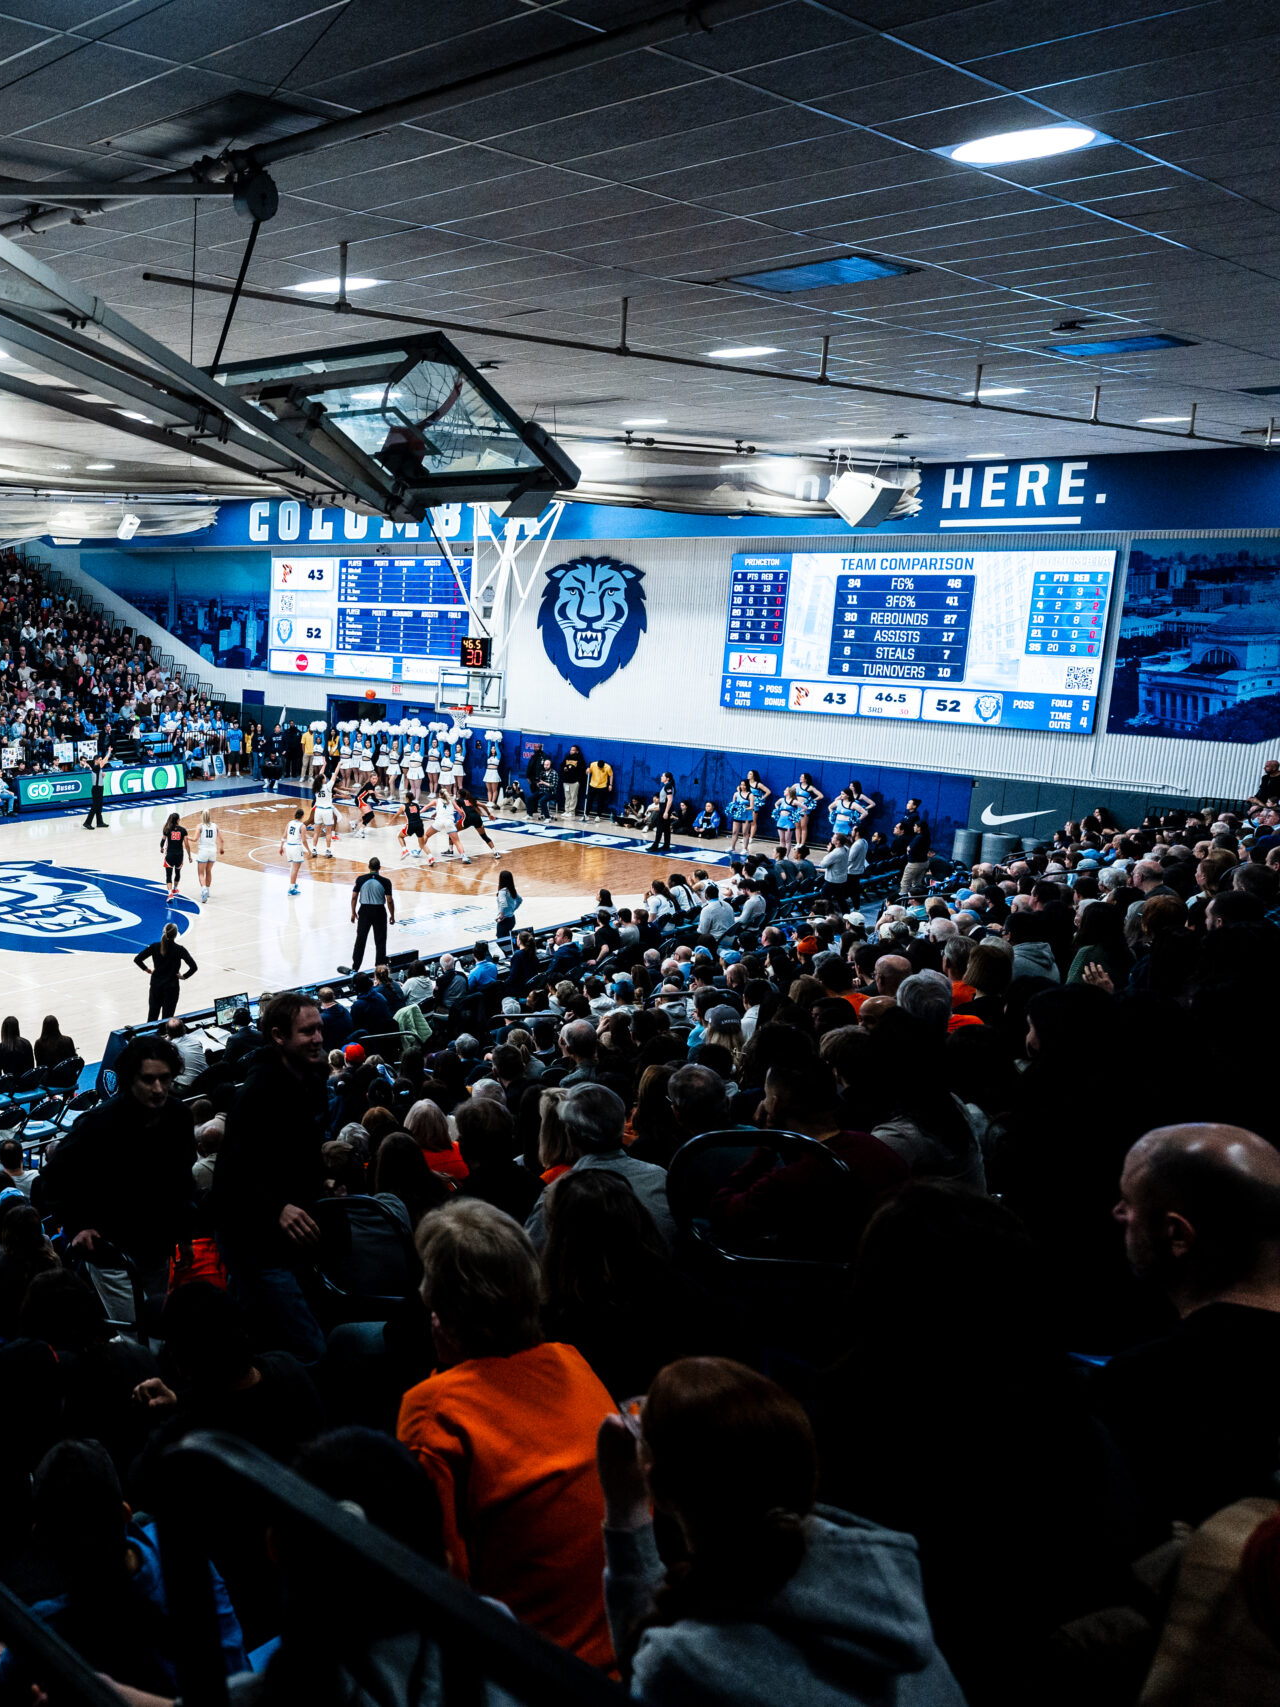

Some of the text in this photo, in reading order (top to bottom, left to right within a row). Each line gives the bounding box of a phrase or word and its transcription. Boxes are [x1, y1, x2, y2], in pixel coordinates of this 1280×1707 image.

[942, 461, 1107, 509] HERE.
[744, 558, 780, 566] PRINCETON
[841, 557, 975, 571] TEAM COMPARISON
[307, 569, 324, 580] 43
[747, 573, 759, 581] PTS
[760, 573, 774, 581] REB
[779, 573, 784, 581] F
[1053, 574, 1069, 582] PTS
[1073, 574, 1090, 582] REB
[1097, 574, 1103, 583] F
[762, 585, 771, 593] 13
[777, 585, 782, 593] 1
[847, 577, 962, 590] 34 FG% 46
[1038, 587, 1045, 596] 1
[1056, 587, 1064, 596] 4
[1095, 587, 1100, 596] 1
[763, 597, 768, 605] 1
[776, 597, 782, 605] 0
[847, 595, 959, 608] 11 3FG% 41
[1036, 601, 1044, 610] 4
[1055, 601, 1062, 610] 2
[1092, 602, 1100, 610] 2
[745, 609, 754, 617] 10
[761, 609, 767, 617] 4
[775, 609, 780, 617] 0
[844, 612, 957, 625] 30 REBOUNDS 27
[746, 621, 752, 629] 4
[760, 621, 766, 629] 2
[773, 621, 779, 629] 2
[1032, 615, 1044, 623] 10
[1053, 615, 1059, 624] 7
[1091, 616, 1098, 625] 2
[306, 628, 322, 639] 52
[759, 633, 765, 641] 4
[772, 633, 778, 641] 0
[843, 629, 955, 643] 12 ASSISTS 17
[1030, 629, 1096, 639] 21 0 0 0
[463, 639, 481, 649] 46.5
[1047, 643, 1059, 652] 20
[1087, 645, 1094, 653] 0
[466, 649, 483, 666] 30
[875, 647, 915, 660] STEALS
[943, 650, 950, 660] 7
[862, 664, 926, 678] TURNOVERS
[937, 668, 951, 678] 10
[725, 678, 783, 694] 2 FOULS POSS
[724, 690, 752, 703] 4 TIME
[764, 697, 786, 706] BONUS
[823, 692, 847, 705] 43
[875, 692, 907, 703] 46.5
[867, 706, 883, 714] 3RD
[935, 699, 961, 712] 52
[1013, 699, 1090, 711] POSS FOULS 5
[1048, 720, 1071, 729] OUTS
[1050, 711, 1088, 728] TIME 4
[110, 764, 177, 796] GO
[28, 784, 75, 796] GO Buses
[205, 829, 214, 838] 10
